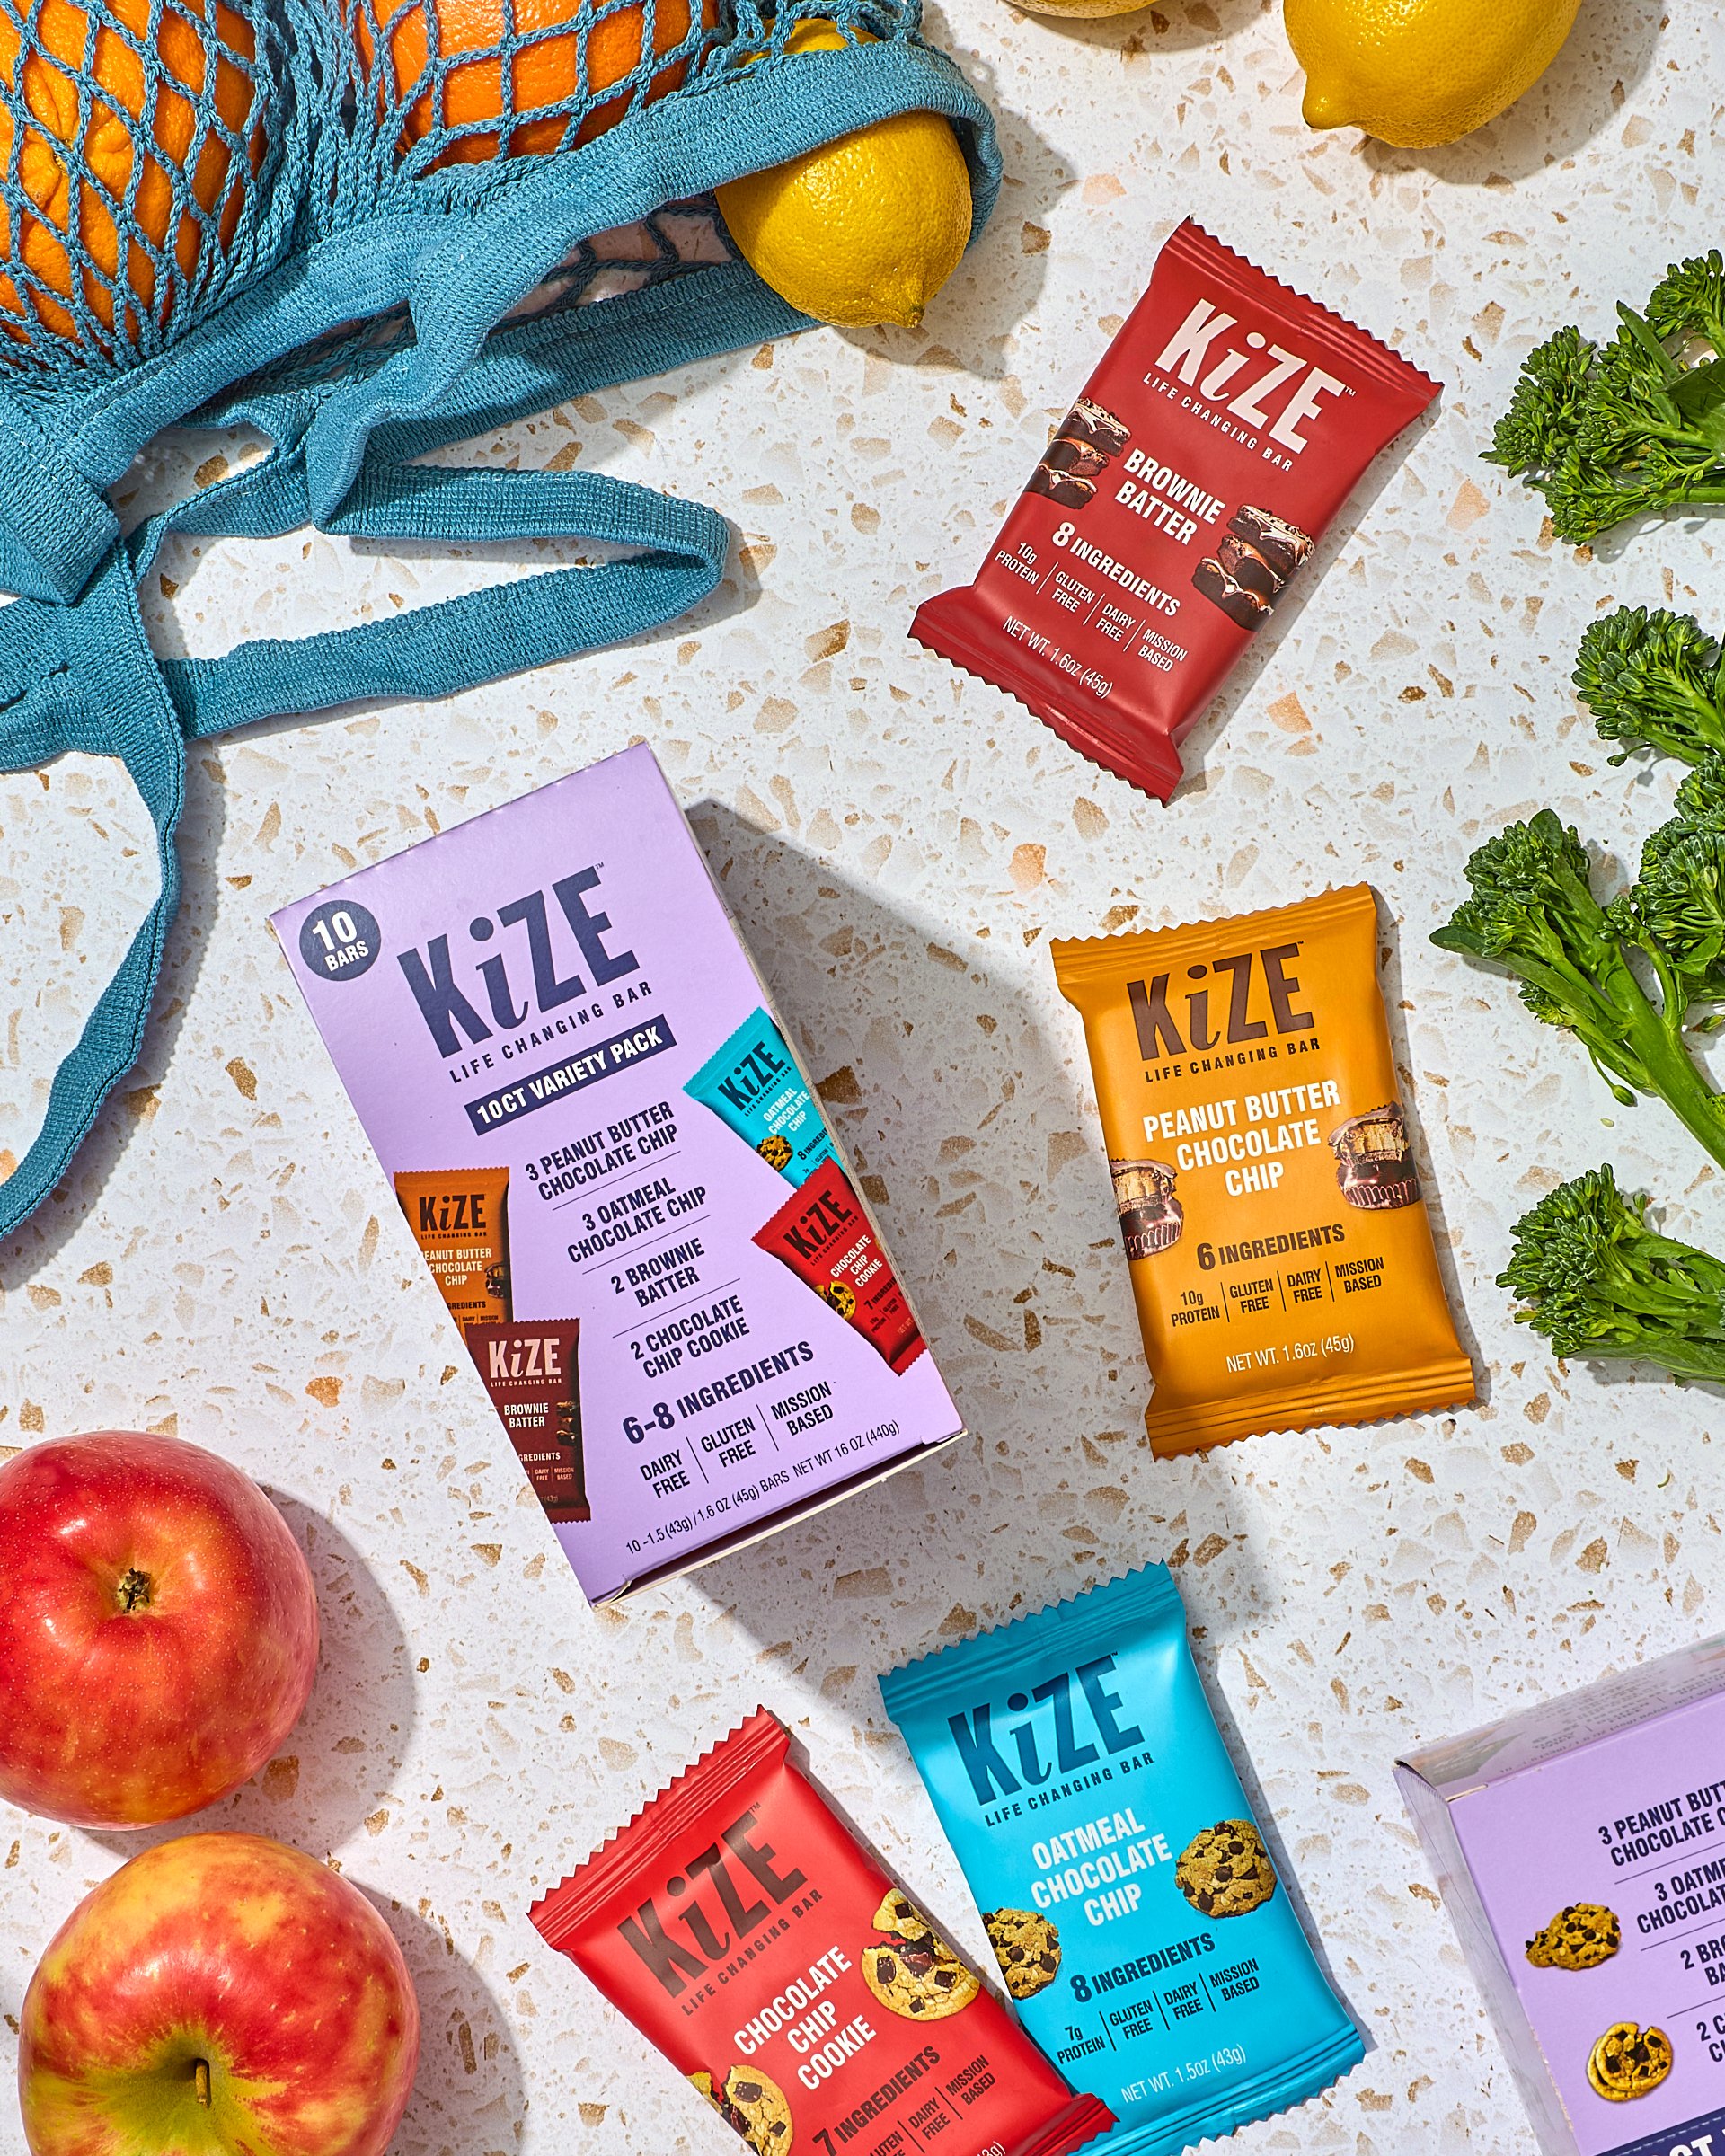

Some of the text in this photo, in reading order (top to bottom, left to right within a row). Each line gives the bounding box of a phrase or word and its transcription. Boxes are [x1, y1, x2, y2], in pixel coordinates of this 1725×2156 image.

[1154, 296, 1346, 455] KiZE
[1142, 372, 1293, 472] LIFE CHANGING BAR
[1122, 447, 1225, 525] BROWNIE
[1114, 479, 1198, 545] BATTER
[994, 550, 1039, 585] PROTEIN
[1015, 542, 1039, 565] 10g
[1050, 520, 1181, 616] 8 INGREDIENTS
[1051, 588, 1080, 613] FREE
[1054, 570, 1096, 604] GLUTEN
[1095, 617, 1124, 641] FREE
[1101, 602, 1136, 630] DAIRY
[1002, 615, 1113, 700] NET WT. 1.6oz (45g)
[1137, 644, 1173, 672] BASED
[1142, 627, 1188, 662] MISSION
[310, 909, 358, 952] 10
[323, 939, 369, 971] BARS
[395, 865, 641, 1059] KiZE
[1125, 941, 1314, 1062] KiZE
[448, 980, 652, 1083] LIFE CHANGING BAR
[475, 1025, 663, 1124] 10CT VARIETY PACK
[716, 1040, 786, 1111] KiZE
[1144, 1038, 1320, 1082] LIFE CHANGING BAR
[762, 1086, 798, 1122] OATMEAL
[767, 1090, 810, 1135] CHOCOLATE
[787, 1109, 808, 1132] CHIP
[1142, 1079, 1341, 1143] PEANUT BUTTER
[524, 1100, 674, 1181] 3 PEANUT BUTTER
[796, 1150, 807, 1161] 8
[1175, 1118, 1321, 1171] CHOCOLATE
[536, 1123, 679, 1201] CHOCOLATE CHIP
[1224, 1160, 1285, 1197] CHIP
[419, 1193, 486, 1232] KiZE
[581, 1176, 676, 1231] 3 OATMEAL
[566, 1185, 708, 1263] CHOCOLATE CHIP
[782, 1188, 853, 1260] KiZE
[423, 1247, 491, 1260] EANUT BUTTER
[609, 1237, 705, 1294] 2 BROWNIE
[829, 1233, 871, 1277] CHOCOLATE
[849, 1253, 869, 1275] CHIP
[1196, 1223, 1346, 1271] 6 INGREDIENTS
[445, 1274, 467, 1286] CHIP
[633, 1265, 700, 1307] BATTER
[854, 1258, 883, 1287] COOKIE
[1286, 1268, 1322, 1287] DAIRY
[1334, 1256, 1384, 1278] MISSION
[1343, 1274, 1382, 1294] BASED
[863, 1299, 874, 1310] 7
[1180, 1289, 1204, 1307] 10g
[1228, 1277, 1274, 1299] GLUTEN
[1240, 1295, 1269, 1313] FREE
[1292, 1286, 1322, 1303] FREE
[629, 1294, 744, 1360] 2 CHOCOLATE
[1171, 1305, 1220, 1327] PROTEIN
[488, 1338, 561, 1378] KiZE
[641, 1316, 750, 1378] CHIP COOKIE
[1225, 1332, 1355, 1373] NET WT. 1.6oz (45g)
[675, 1339, 815, 1418] INGREDIENTS
[503, 1402, 548, 1415] BROWNIE
[770, 1380, 832, 1420] MISSION
[785, 1403, 834, 1436] BASED
[509, 1416, 544, 1427] BATTER
[700, 1416, 756, 1453] GLUTEN
[639, 1449, 684, 1481] DAIRY
[718, 1439, 756, 1468] FREE
[625, 1539, 641, 1554] 10
[714, 1497, 731, 1513] OZ
[730, 1483, 760, 1508] (45g)
[758, 1469, 790, 1492] BARS
[792, 1457, 815, 1477] NET
[813, 1448, 834, 1467] WT
[833, 1442, 849, 1458] 16
[848, 1434, 865, 1451] OZ
[864, 1418, 900, 1446] (440g)
[651, 1470, 690, 1498] FREE
[946, 1654, 1146, 1807] KiZE
[984, 1751, 1154, 1827] LIFE CHANGING BAR
[1031, 1805, 1146, 1870] OATMEAL
[1597, 1825, 1613, 1845] 3
[1613, 1798, 1685, 1840] PEANUT
[1609, 1812, 1715, 1867] CHOCOLATE
[1029, 1832, 1172, 1909] CHOCOLATE
[617, 1811, 808, 1999] KiZE
[1083, 1881, 1144, 1927] CHIP
[1653, 1881, 1668, 1902] 3
[680, 1888, 823, 2016] LIFE CHANGING BAR
[1068, 1931, 1216, 2003] 8 INGREDIENTS
[1679, 1948, 1694, 1970] 2
[1208, 1957, 1259, 1987] MISSION
[1220, 1975, 1260, 2001] BASED
[731, 1944, 853, 2056] CHOCOLATE
[1163, 1981, 1199, 2005] DAIRY
[1172, 1997, 1204, 2020] FREE
[785, 1999, 841, 2054] CHIP
[1108, 1999, 1154, 2027] GLUTEN
[1121, 2017, 1153, 2039] FREE
[1696, 2022, 1711, 2041] 2
[795, 2013, 877, 2090] COOKIE
[1056, 2035, 1106, 2064] PROTEIN
[1064, 2024, 1084, 2042] 7g
[944, 2054, 990, 2096] MISSION
[960, 2072, 996, 2106] BASED
[1120, 2042, 1247, 2103] NET WT. 1.5oz (43g)
[812, 2045, 942, 2156] 7 INGREDIENTS
[907, 2096, 941, 2129] DAIRY
[921, 2111, 951, 2140] FREE
